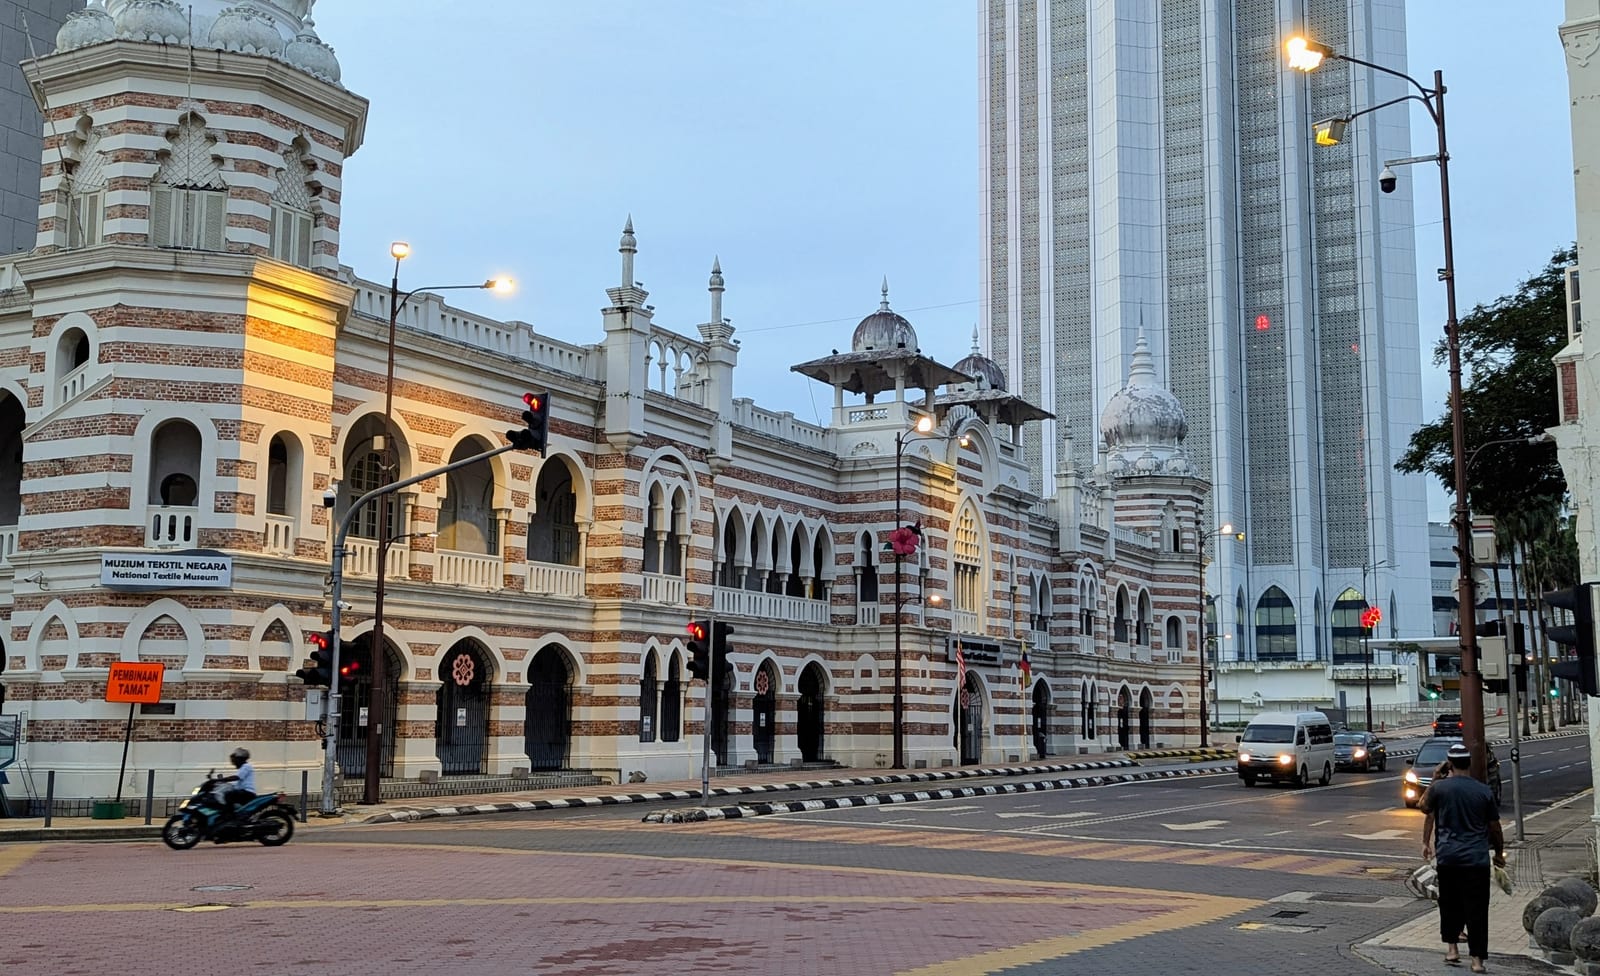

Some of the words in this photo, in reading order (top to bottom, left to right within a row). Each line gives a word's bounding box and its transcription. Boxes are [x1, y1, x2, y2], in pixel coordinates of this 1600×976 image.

[104, 559, 145, 568] MUZIUM
[147, 561, 184, 569] TEKSTIL
[186, 562, 227, 571] NEGARA
[112, 570, 151, 579] National
[153, 572, 181, 580] Textile
[183, 573, 219, 581] Museum
[113, 669, 159, 682] PEMBINAAN
[118, 683, 150, 695] TAMAT
